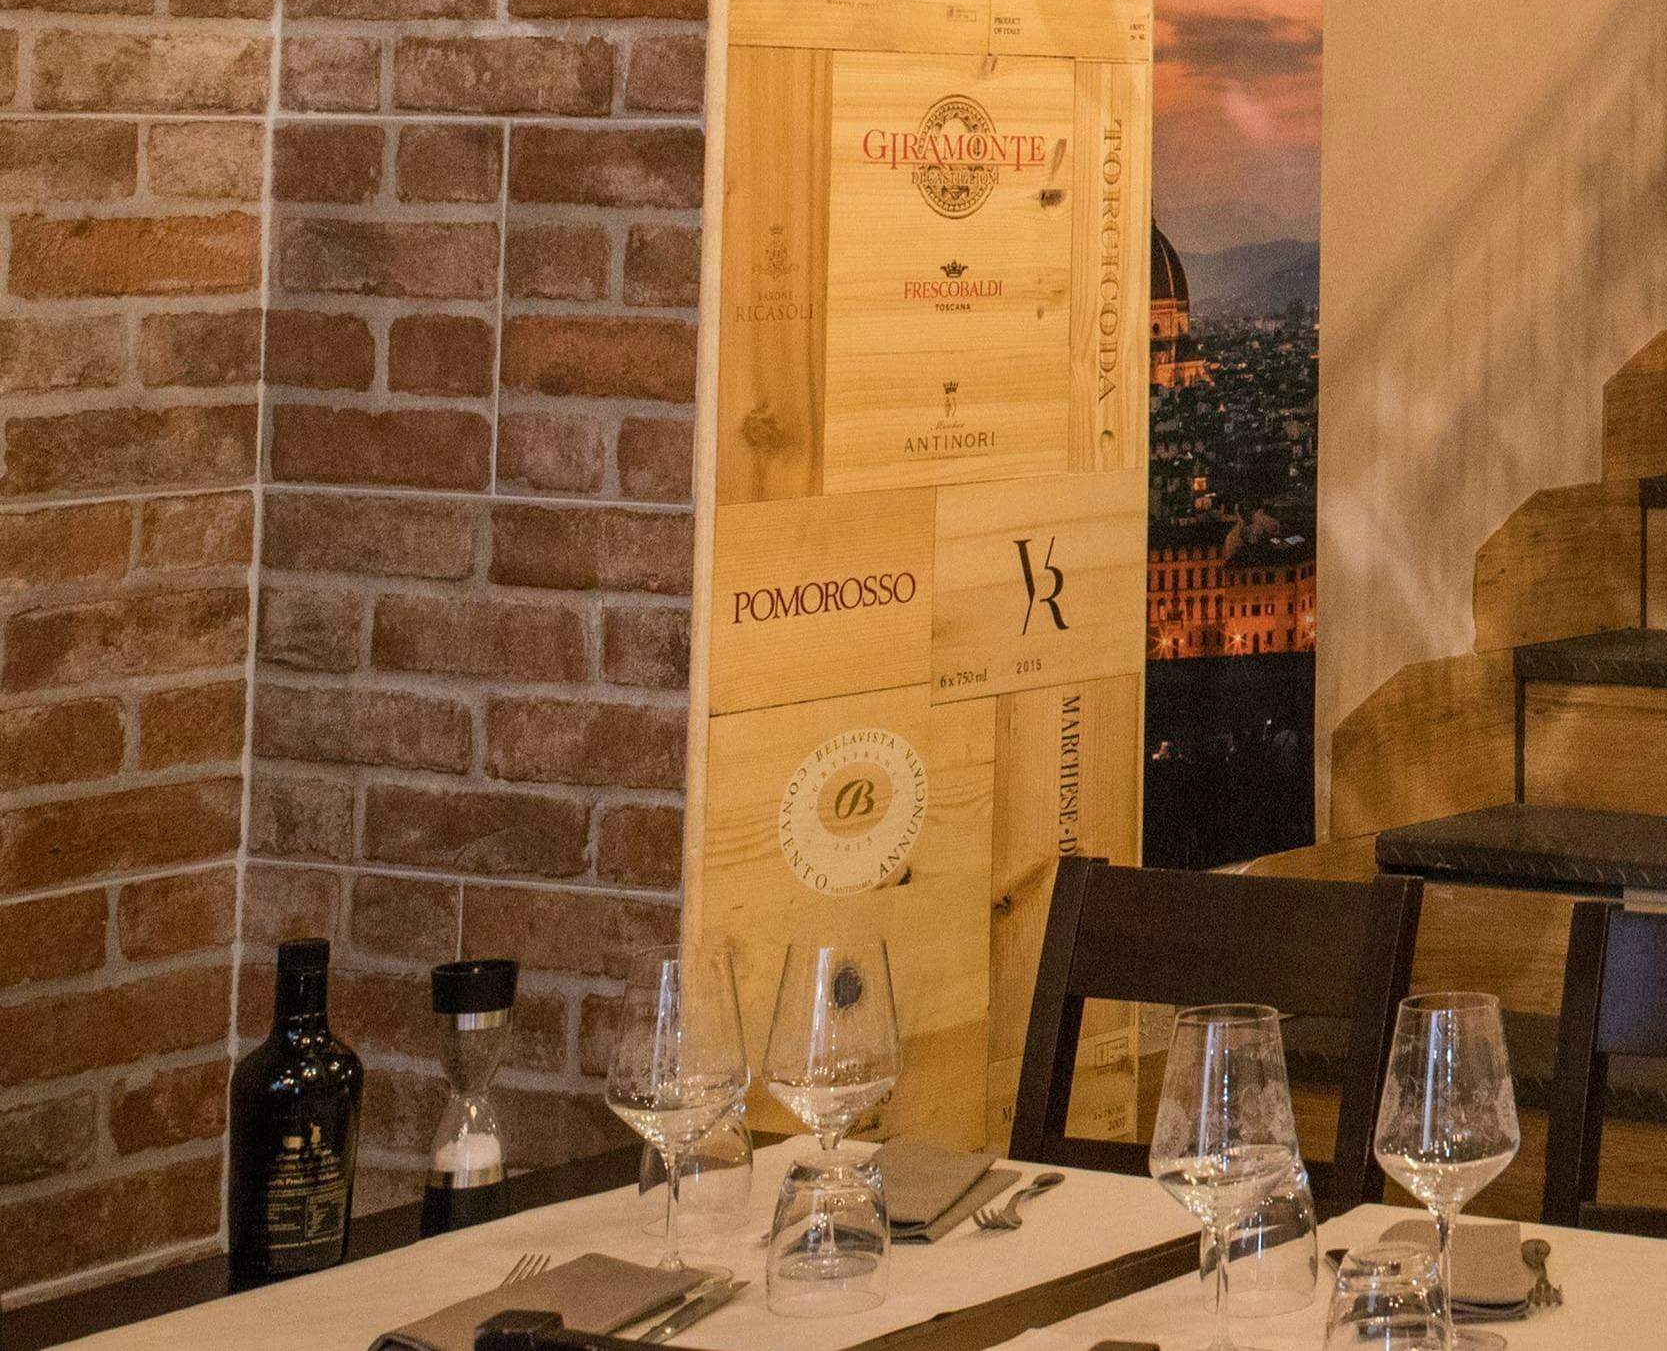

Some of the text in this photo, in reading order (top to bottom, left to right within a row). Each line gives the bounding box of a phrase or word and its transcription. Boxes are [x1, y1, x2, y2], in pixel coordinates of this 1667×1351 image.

[863, 128, 1046, 172] GIRAMONTE
[1099, 118, 1122, 403] TORCICODA
[904, 280, 1003, 300] FRESCOBALDI
[735, 302, 815, 323] RICASOLI
[935, 302, 971, 313] TOSCANA
[904, 431, 997, 454] ANTINORI
[732, 571, 917, 625] POMOROSSO
[940, 674, 948, 689] 6
[956, 671, 974, 686] 750
[1016, 658, 1043, 674] 2015
[815, 731, 896, 763] BELLAVISTA
[1059, 695, 1081, 825] MARCHESE
[834, 778, 875, 820] B
[781, 767, 828, 891] CONVENTO
